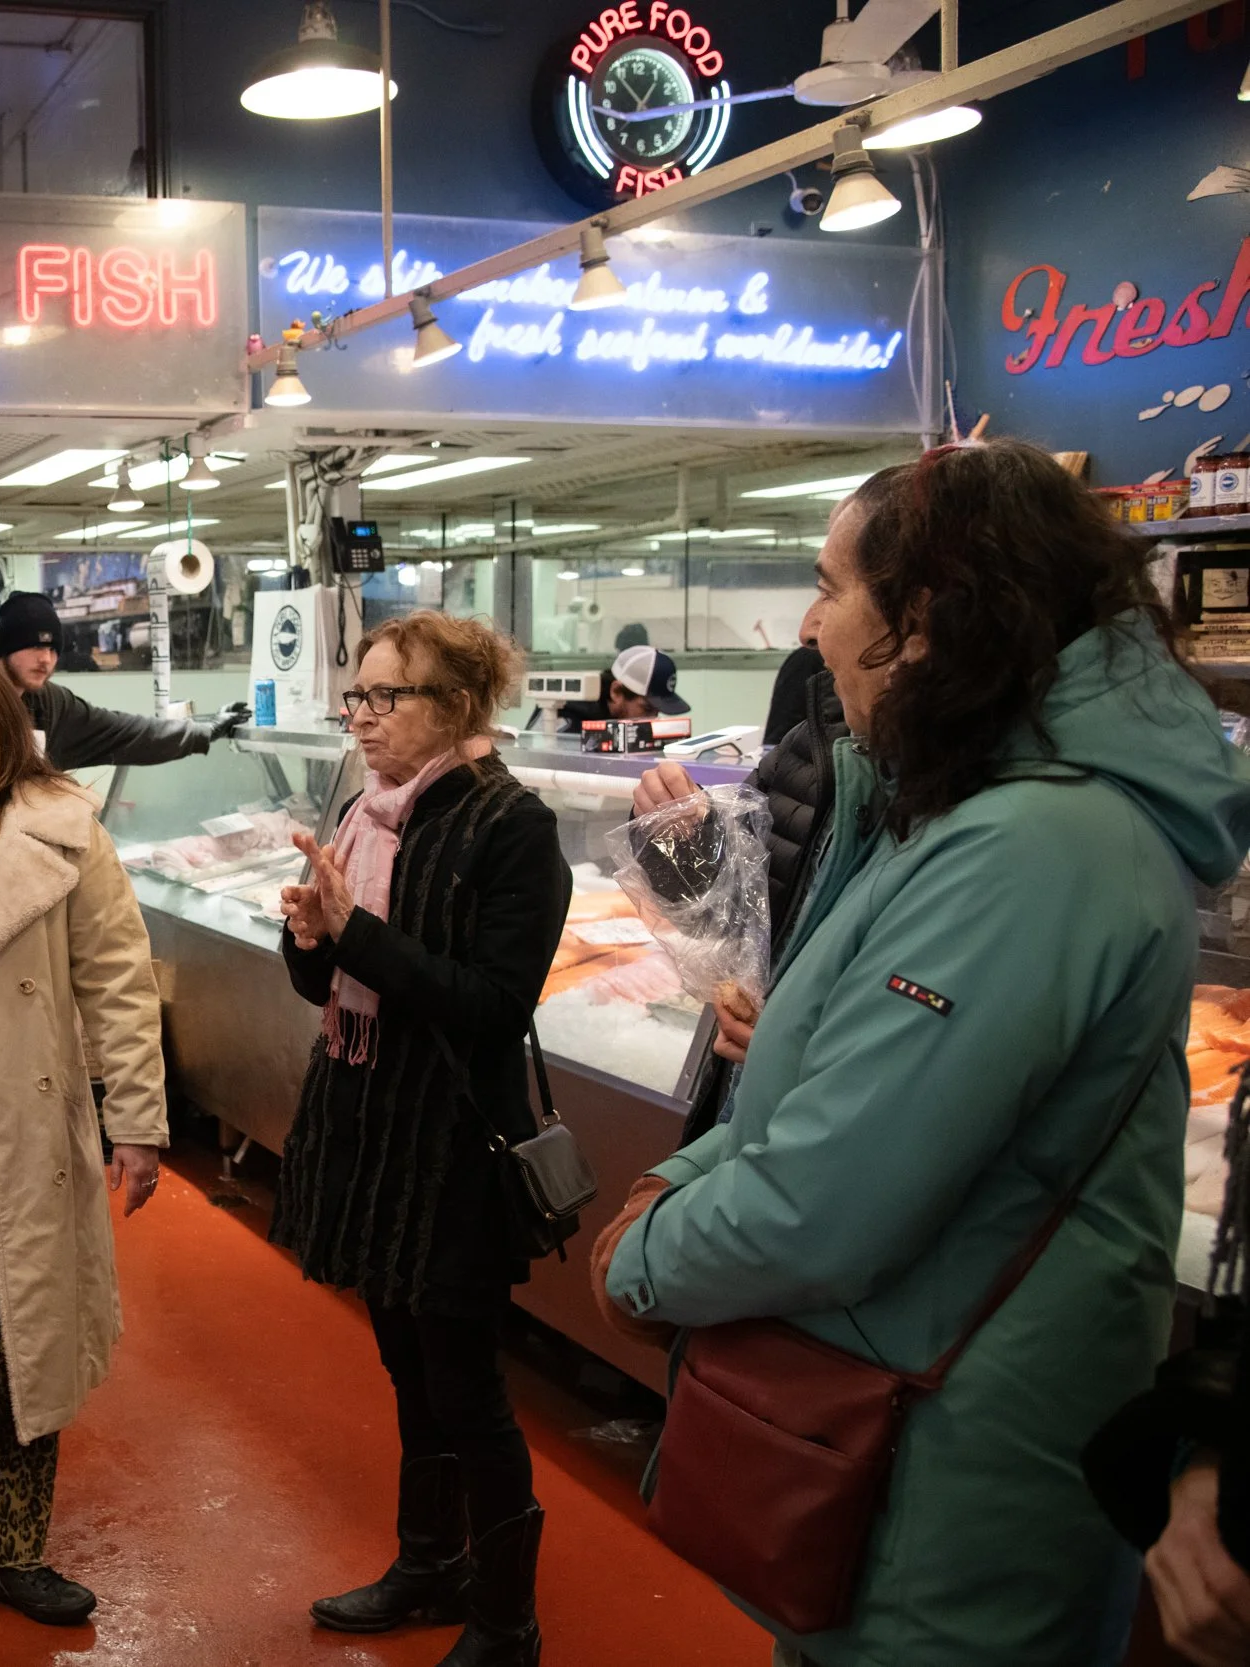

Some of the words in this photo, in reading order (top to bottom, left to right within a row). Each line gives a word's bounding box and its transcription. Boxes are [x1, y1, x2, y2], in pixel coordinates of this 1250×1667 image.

[570, 0, 643, 74] PURE
[649, 1, 724, 77] FOOD
[632, 62, 646, 76] 12
[603, 79, 617, 94] 10
[20, 244, 216, 326] FISH
[279, 250, 349, 294] We
[738, 271, 770, 314] &
[468, 308, 565, 363] fresh
[576, 317, 710, 372] seafood
